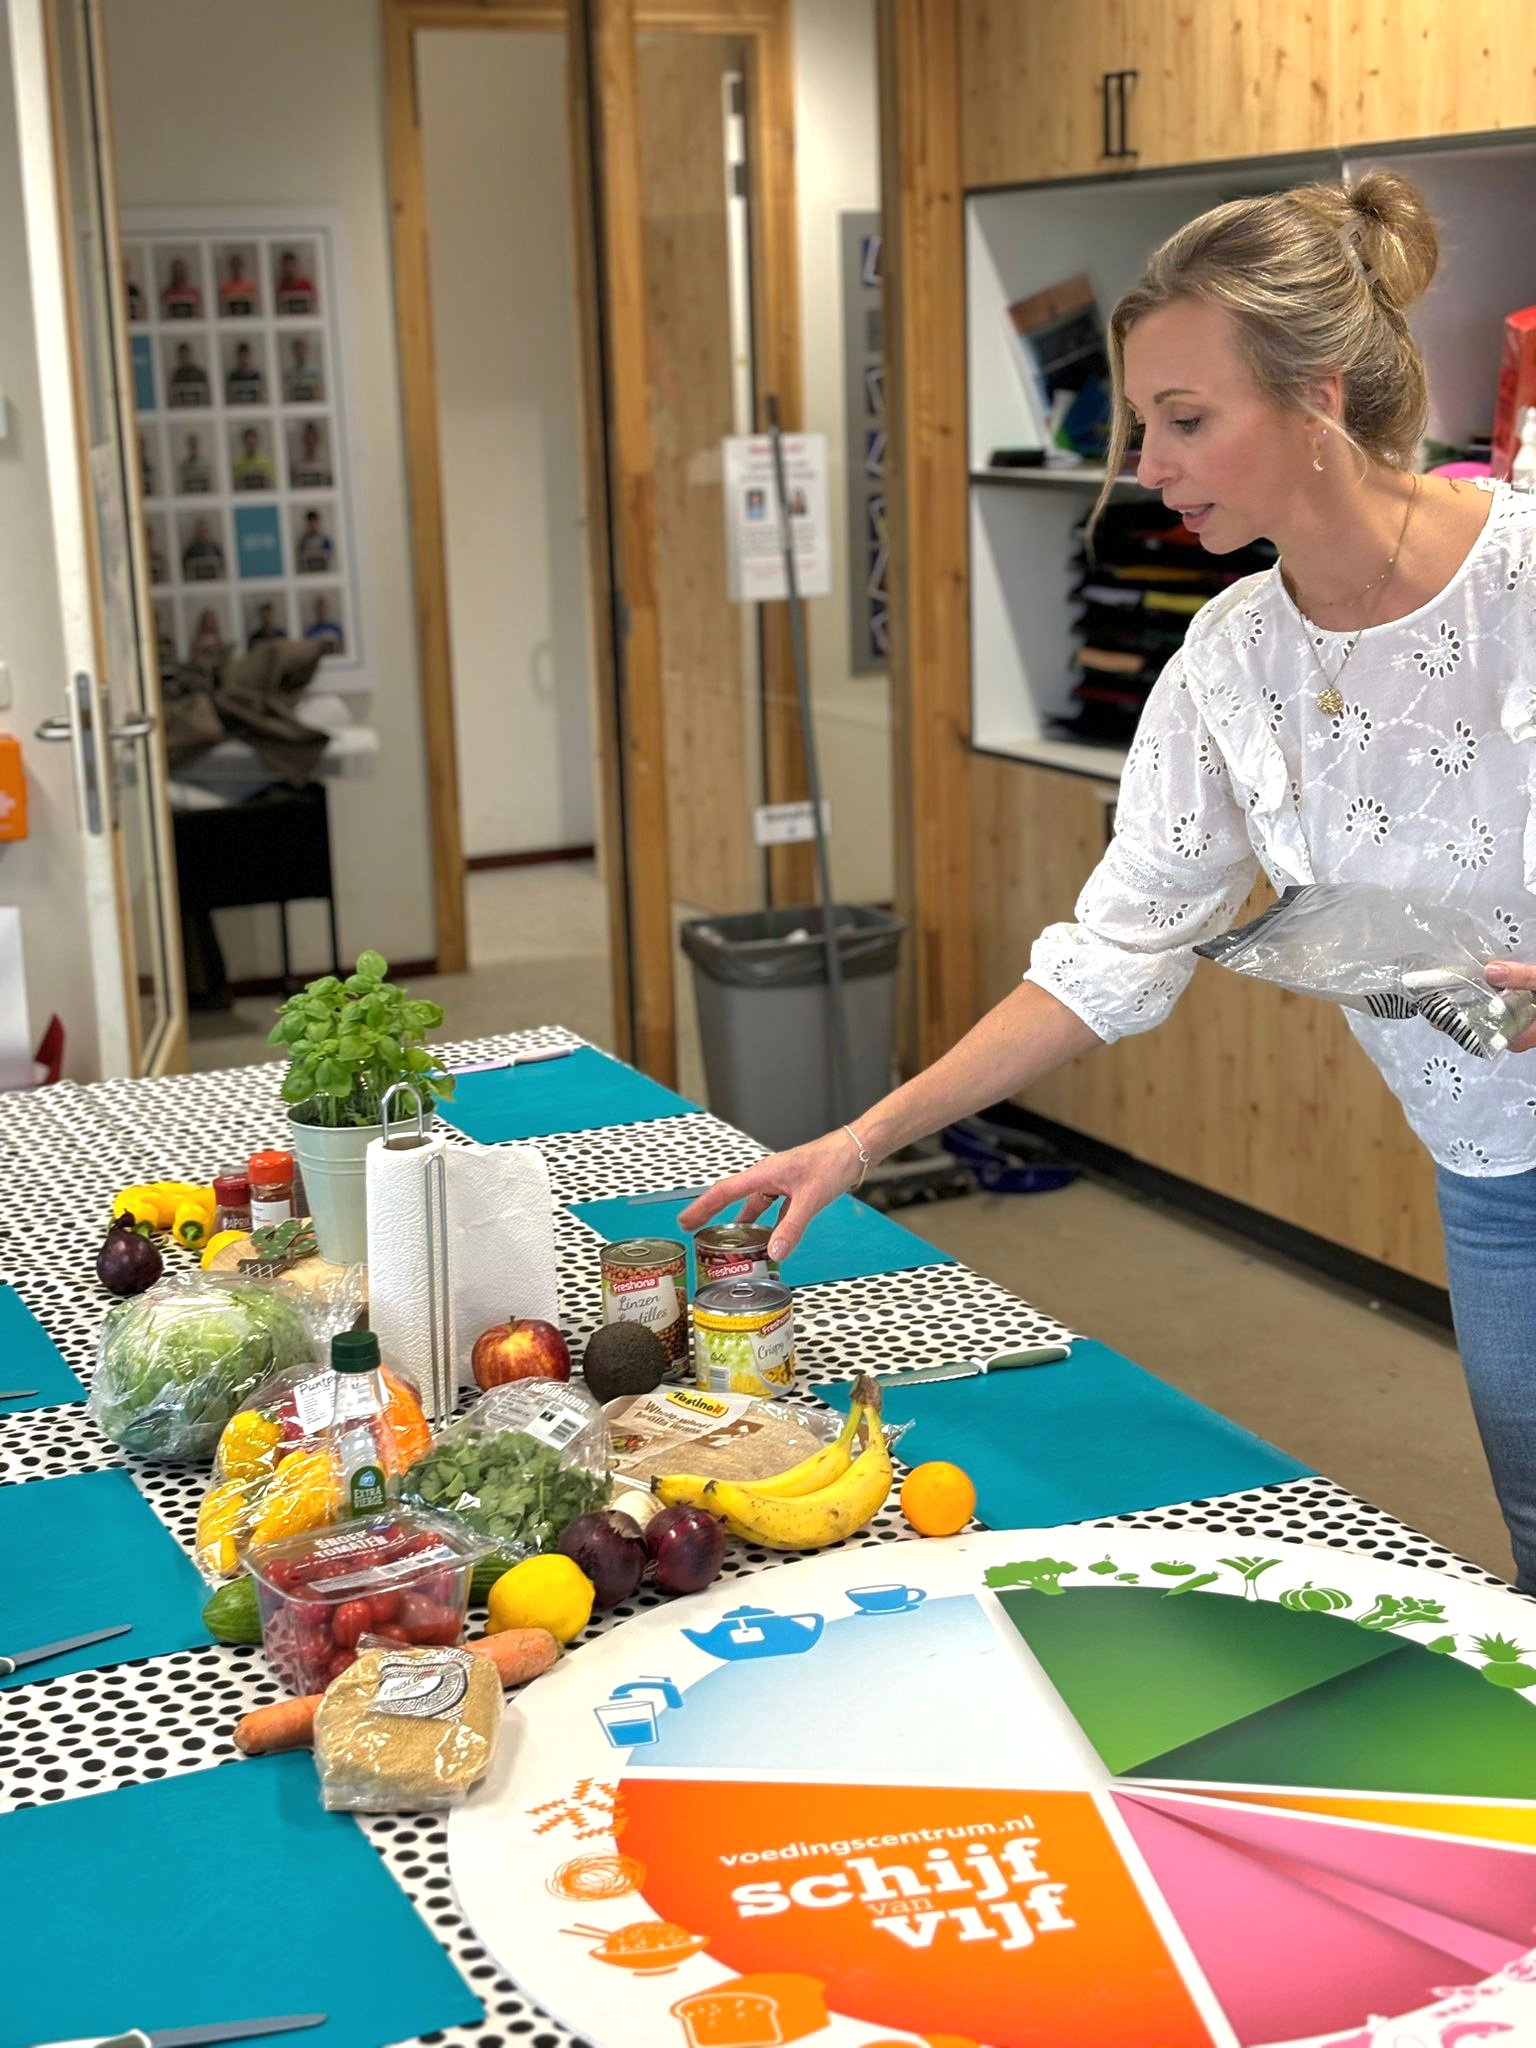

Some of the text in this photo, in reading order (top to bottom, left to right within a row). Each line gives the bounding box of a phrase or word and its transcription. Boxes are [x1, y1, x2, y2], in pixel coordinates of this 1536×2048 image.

[707, 1264, 749, 1278] Freshona
[613, 1279, 656, 1292] Freshona
[617, 1295, 659, 1311] Linzen
[618, 1306, 668, 1323] Lntilles
[758, 1341, 785, 1359] Crispy
[673, 1391, 713, 1412] Tastino
[354, 1485, 382, 1499] EXTRA
[313, 1535, 389, 1558] TOMATEN
[719, 1813, 1036, 1867] voedingscentrum.nl
[730, 1836, 1050, 1918] schijf
[867, 1895, 935, 1917] van
[872, 1882, 1077, 1951] vijf
